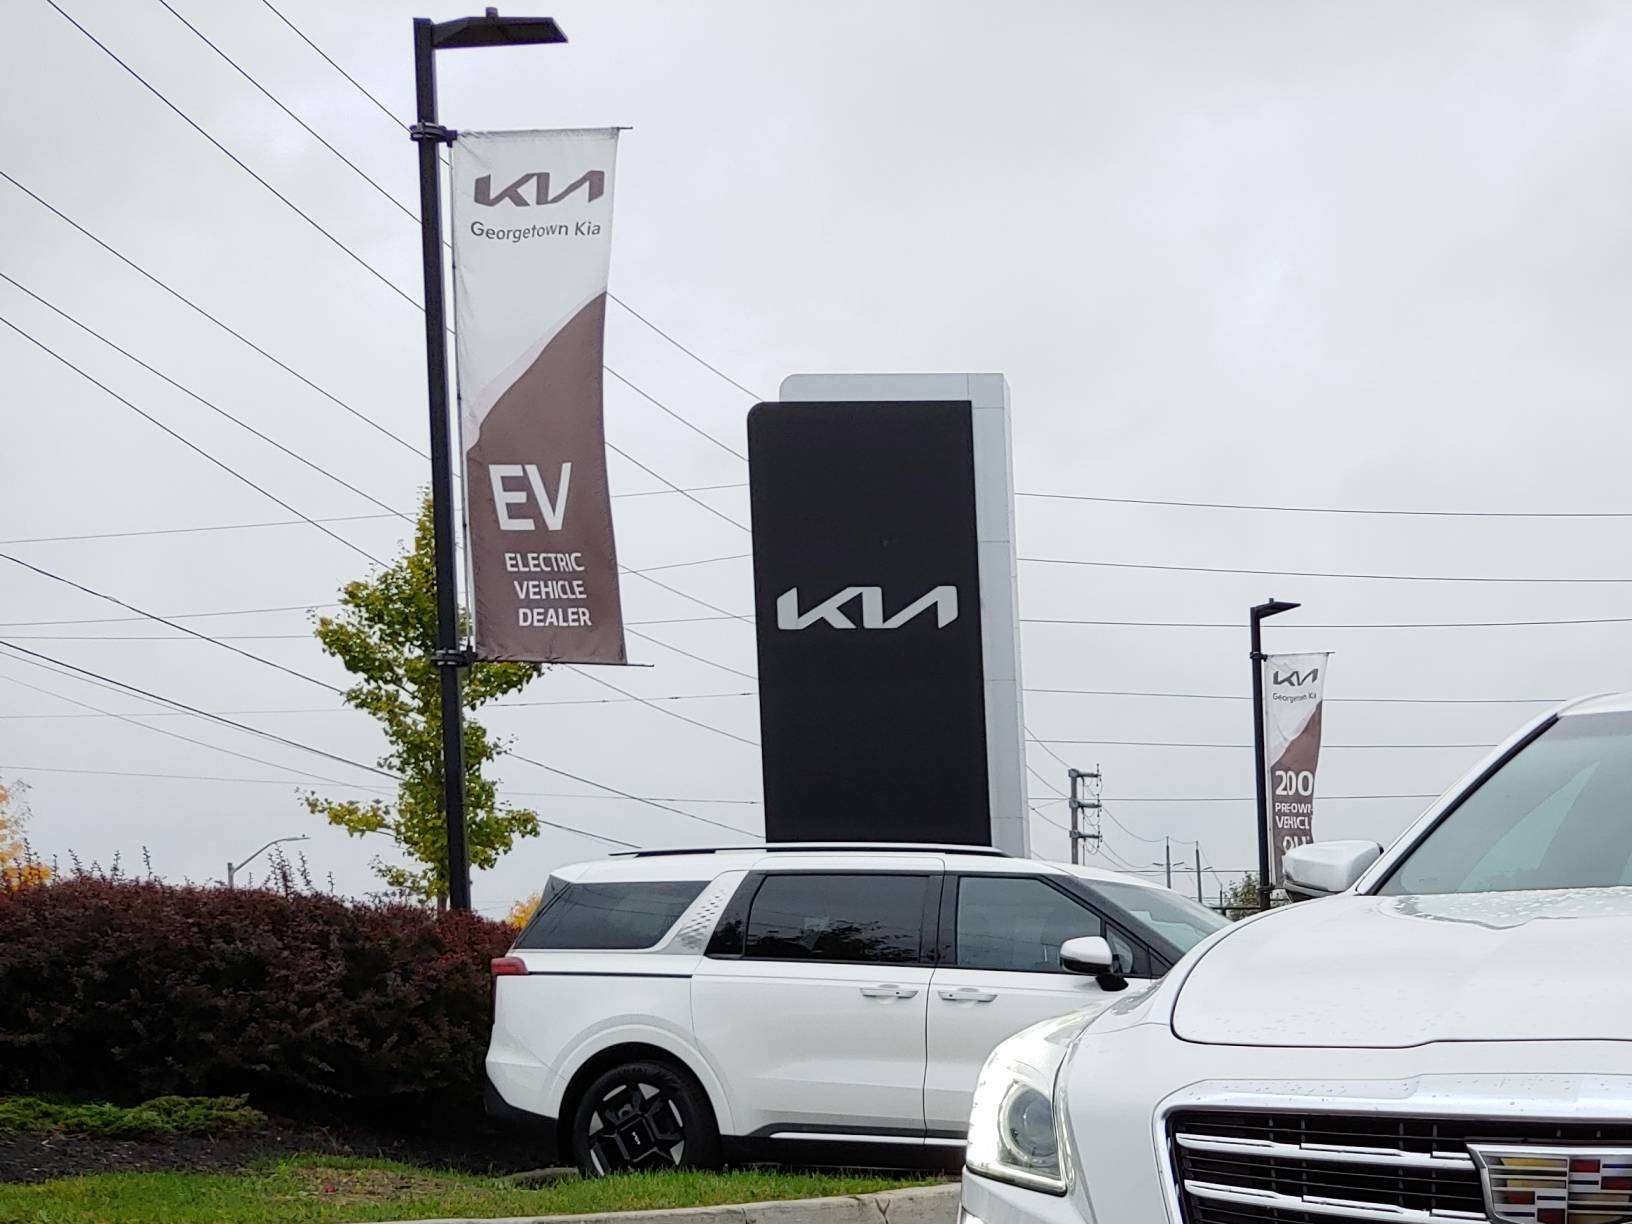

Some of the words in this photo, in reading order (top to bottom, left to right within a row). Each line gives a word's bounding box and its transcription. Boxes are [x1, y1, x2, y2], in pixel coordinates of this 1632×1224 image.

[474, 170, 605, 207] KIA
[470, 221, 569, 243] Georgetown
[574, 221, 601, 236] Kia
[488, 462, 572, 531] EV
[504, 552, 585, 572] ELECTRIC
[513, 580, 587, 599] VEHICLE
[518, 608, 593, 627] DEALER
[776, 585, 959, 630] KIA
